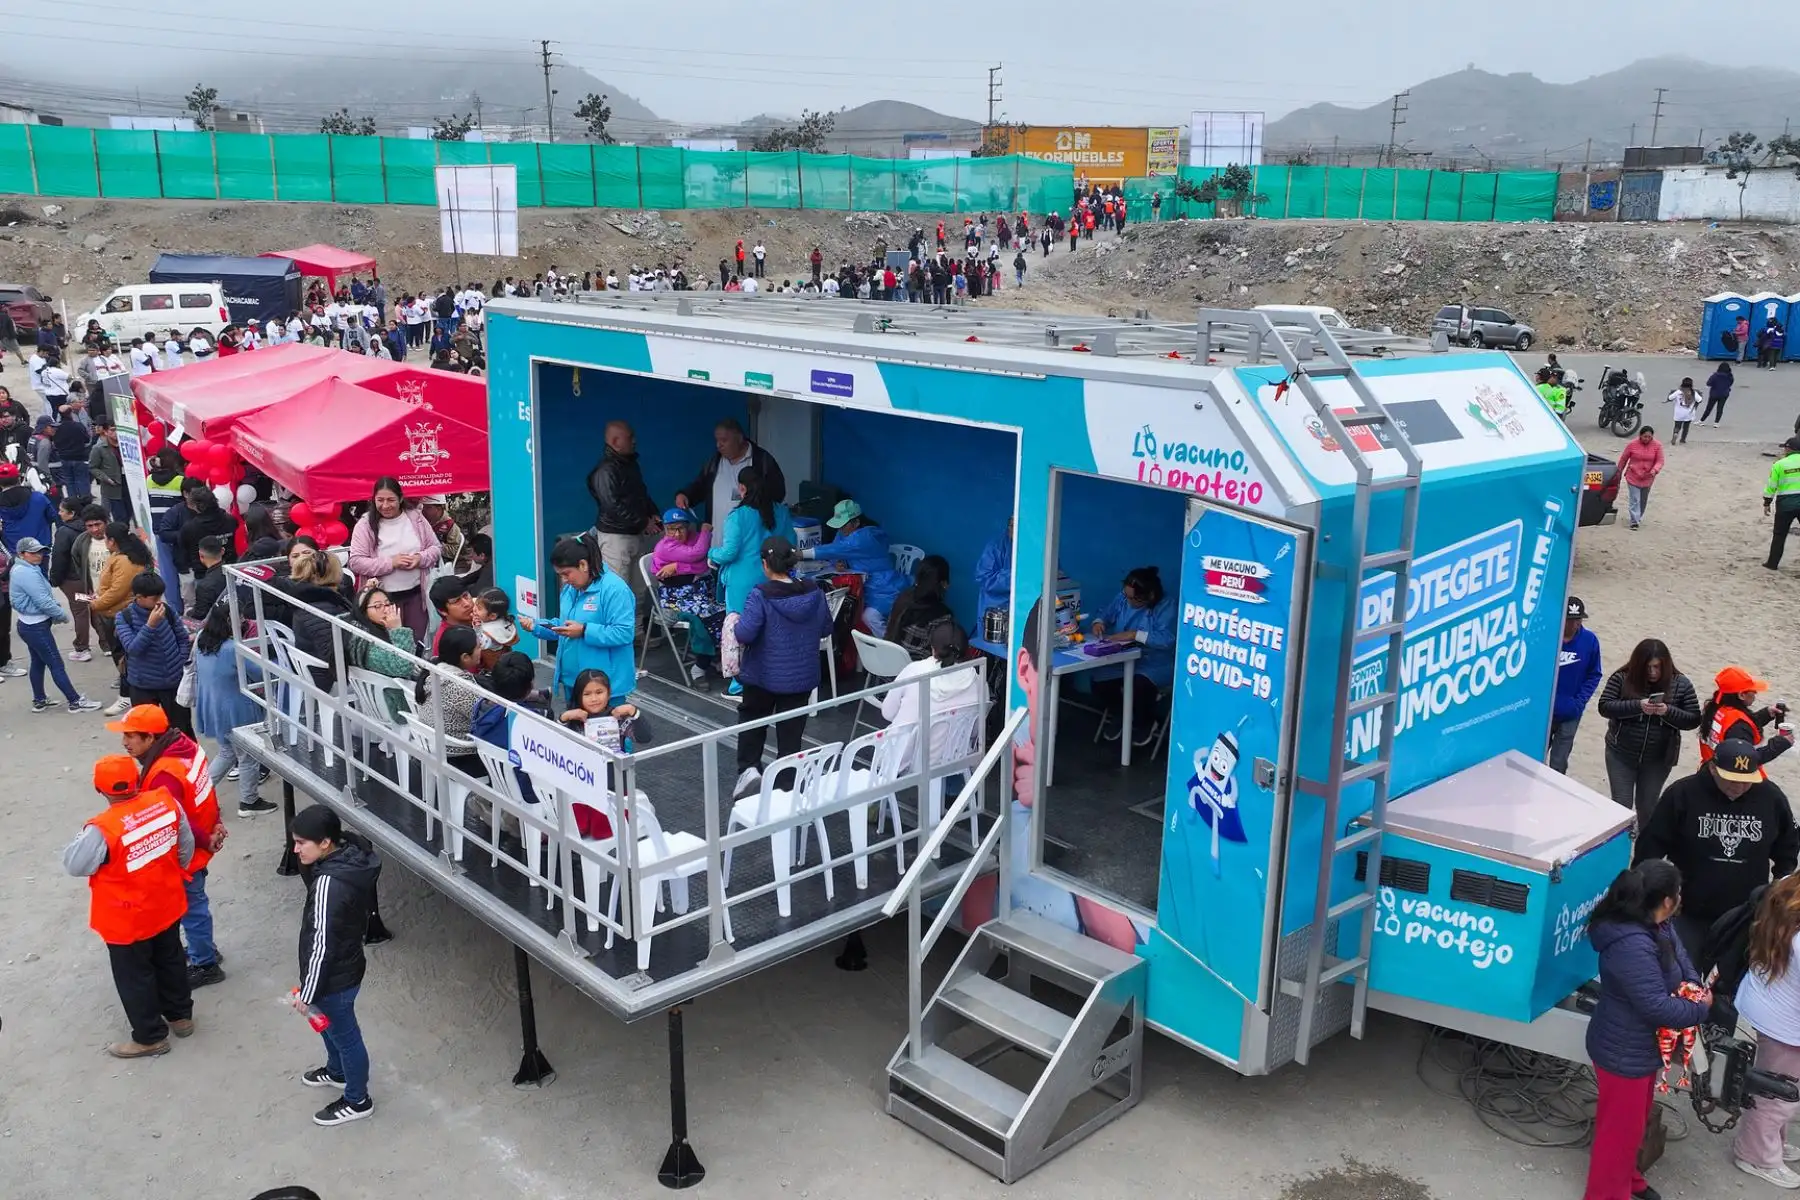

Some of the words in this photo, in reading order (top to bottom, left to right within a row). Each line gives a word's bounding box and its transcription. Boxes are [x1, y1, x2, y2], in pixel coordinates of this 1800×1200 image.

[1163, 442, 1248, 475] vacuno,
[1210, 559, 1222, 569] ME
[1223, 561, 1257, 575] VACUNO
[1220, 575, 1245, 589] PERÚ
[1183, 603, 1284, 651] PROTÉGETE
[1398, 601, 1519, 688] NFLUENZA
[1194, 635, 1247, 664] contra
[1249, 647, 1267, 671] la
[1186, 653, 1272, 700] COVID-19
[522, 735, 595, 786] VACUNACIÓN
[1698, 816, 1763, 842] BUCKS
[1402, 899, 1498, 938] vacuno,
[1405, 922, 1513, 969] protejo
